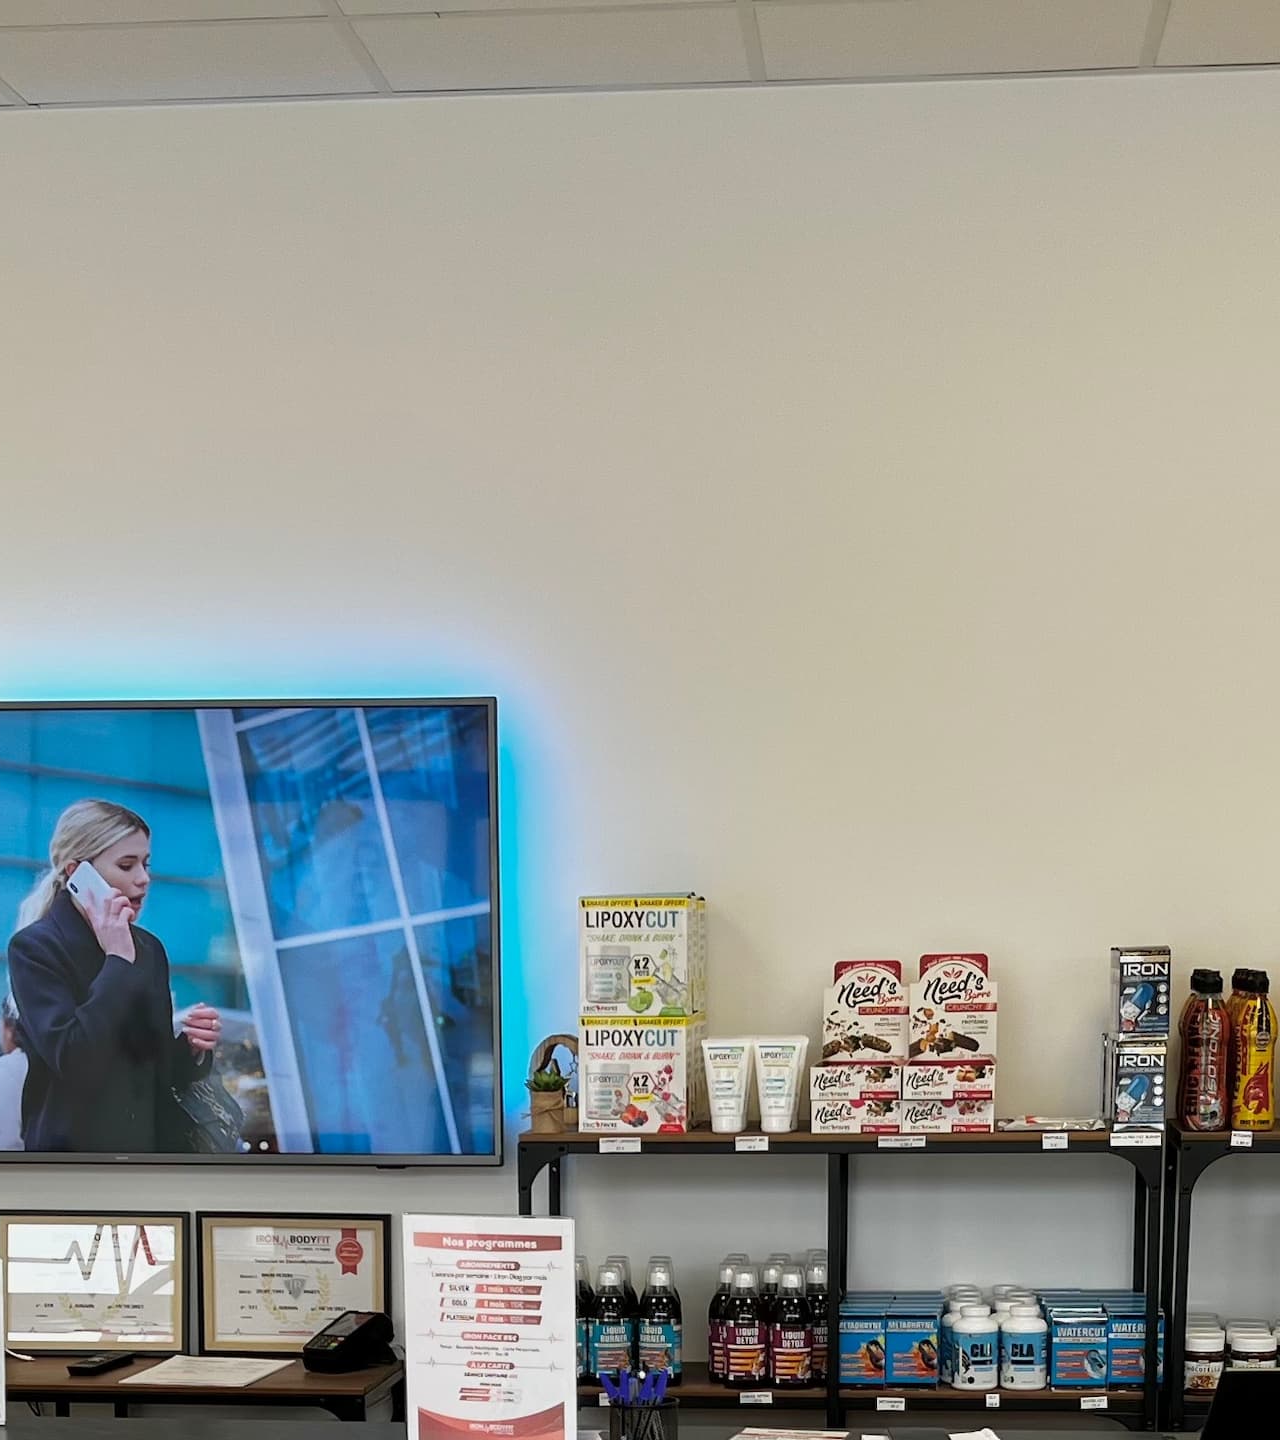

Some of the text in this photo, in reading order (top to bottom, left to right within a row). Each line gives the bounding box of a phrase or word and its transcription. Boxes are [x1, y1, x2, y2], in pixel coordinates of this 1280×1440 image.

[586, 911, 679, 928] LIPOXYCUT
[1123, 963, 1169, 977] IRON
[585, 1030, 678, 1046] LIPOXYCUT
[1120, 1055, 1164, 1068] IRON
[256, 1235, 331, 1244] IRON BODYFIT
[442, 1237, 538, 1251] Nos programmes
[602, 1326, 626, 1334] LIQUID
[735, 1328, 759, 1336] LIQUID
[781, 1331, 805, 1339] LIQUID
[1057, 1327, 1106, 1337] WATERCUT
[736, 1336, 759, 1344] DETOX
[782, 1339, 804, 1348] DETOX
[1011, 1344, 1035, 1357] CLA
